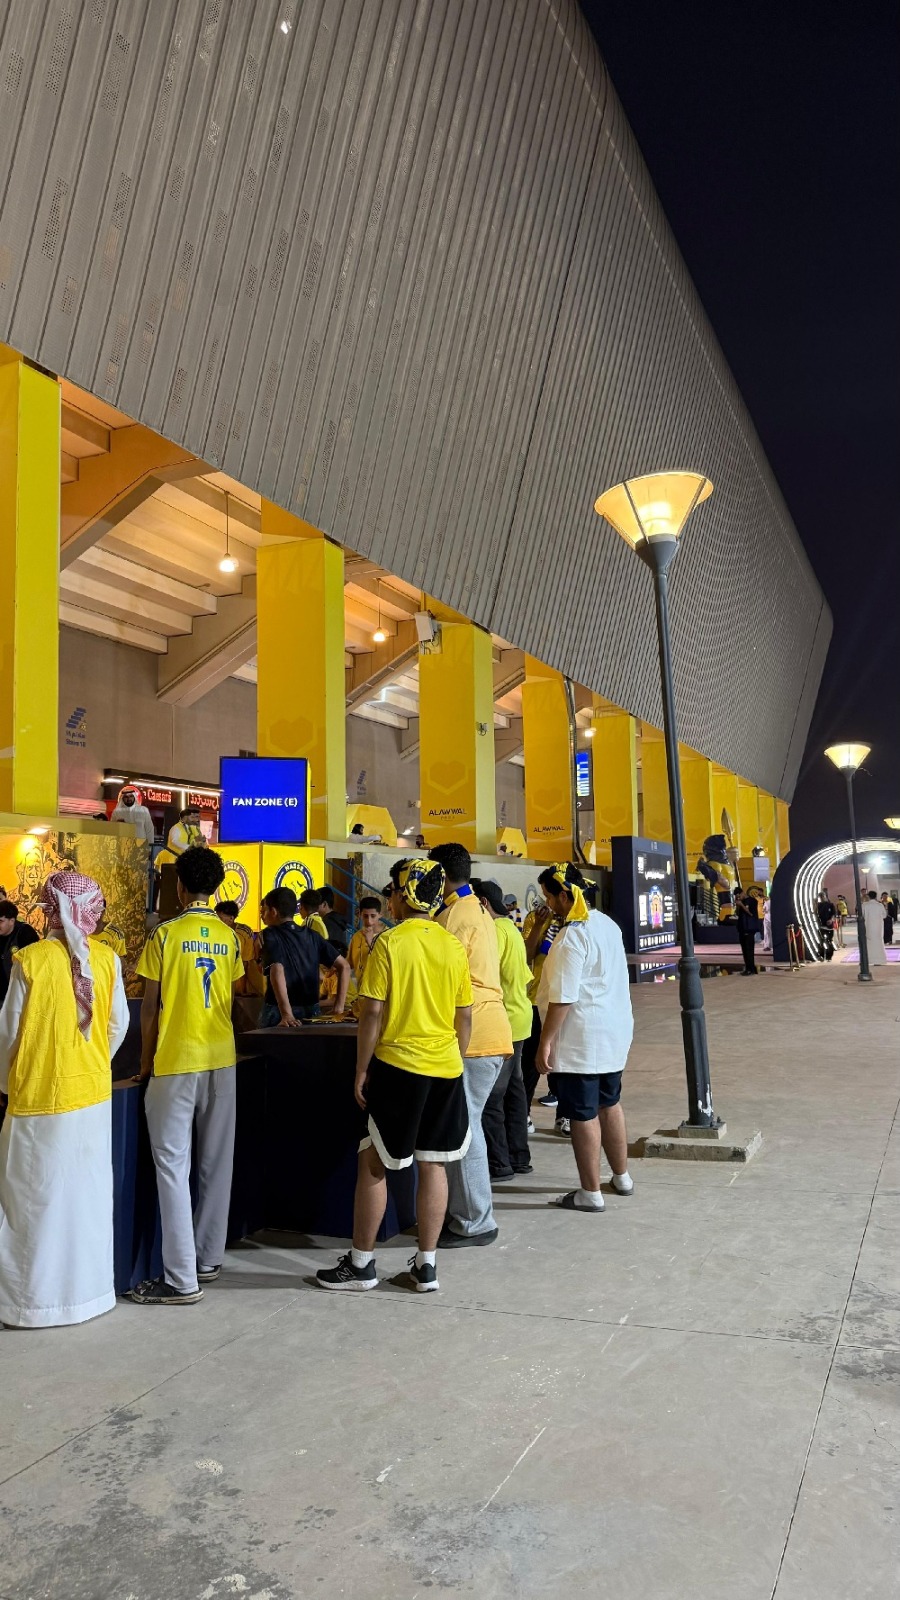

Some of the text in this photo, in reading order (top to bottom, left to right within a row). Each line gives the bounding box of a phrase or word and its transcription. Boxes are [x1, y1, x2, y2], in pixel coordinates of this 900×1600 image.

[232, 797, 298, 807] FAN ZONE (E)
[182, 941, 228, 955] RONALDO
[195, 957, 216, 1008] 7
